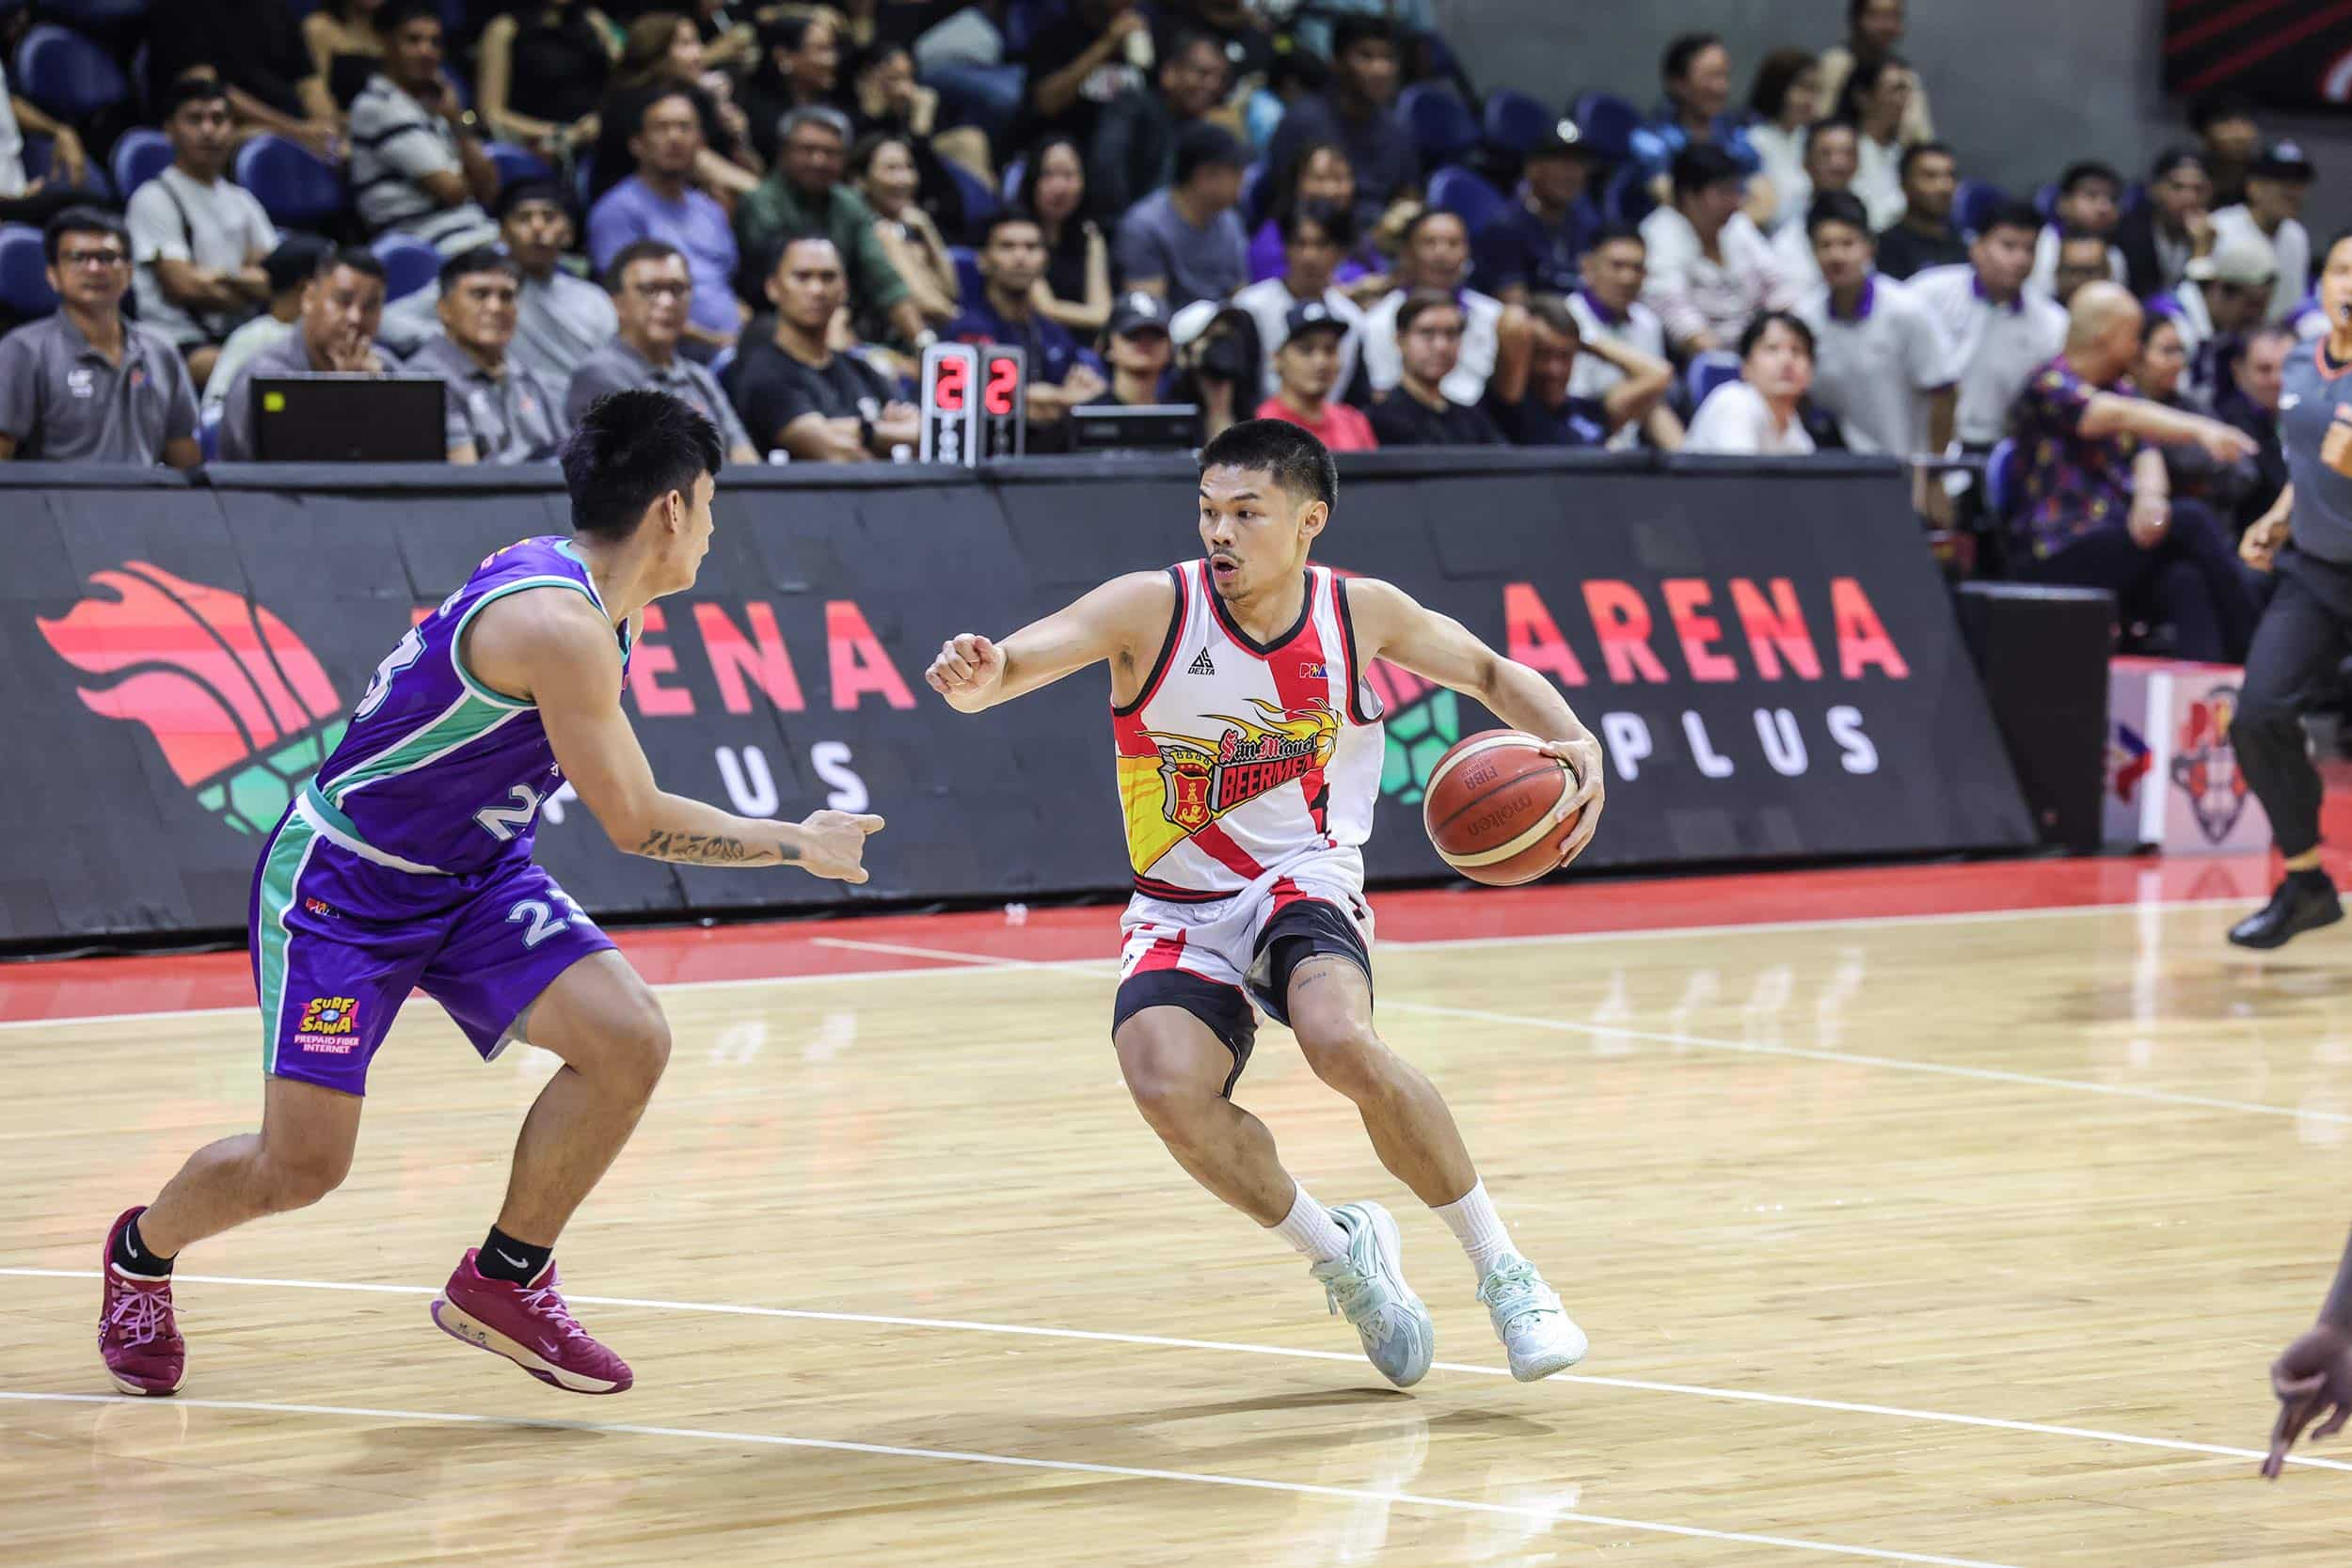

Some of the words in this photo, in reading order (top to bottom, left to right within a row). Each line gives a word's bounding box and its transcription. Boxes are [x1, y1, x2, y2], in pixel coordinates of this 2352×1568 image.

[935, 356, 968, 412] 2
[984, 357, 1018, 415] 2
[1504, 577, 1911, 688] ARENA
[1187, 667, 1216, 676] DELTA
[1299, 662, 1329, 678] PBA
[1601, 705, 1880, 783] PLUS
[1219, 752, 1318, 809] BEERMEN
[1465, 767, 1498, 790] FIBA
[1468, 794, 1533, 836] molten
[294, 1035, 336, 1044] PREPAID
[300, 1016, 352, 1034] SAWA
[303, 1044, 349, 1053] INTERNET
